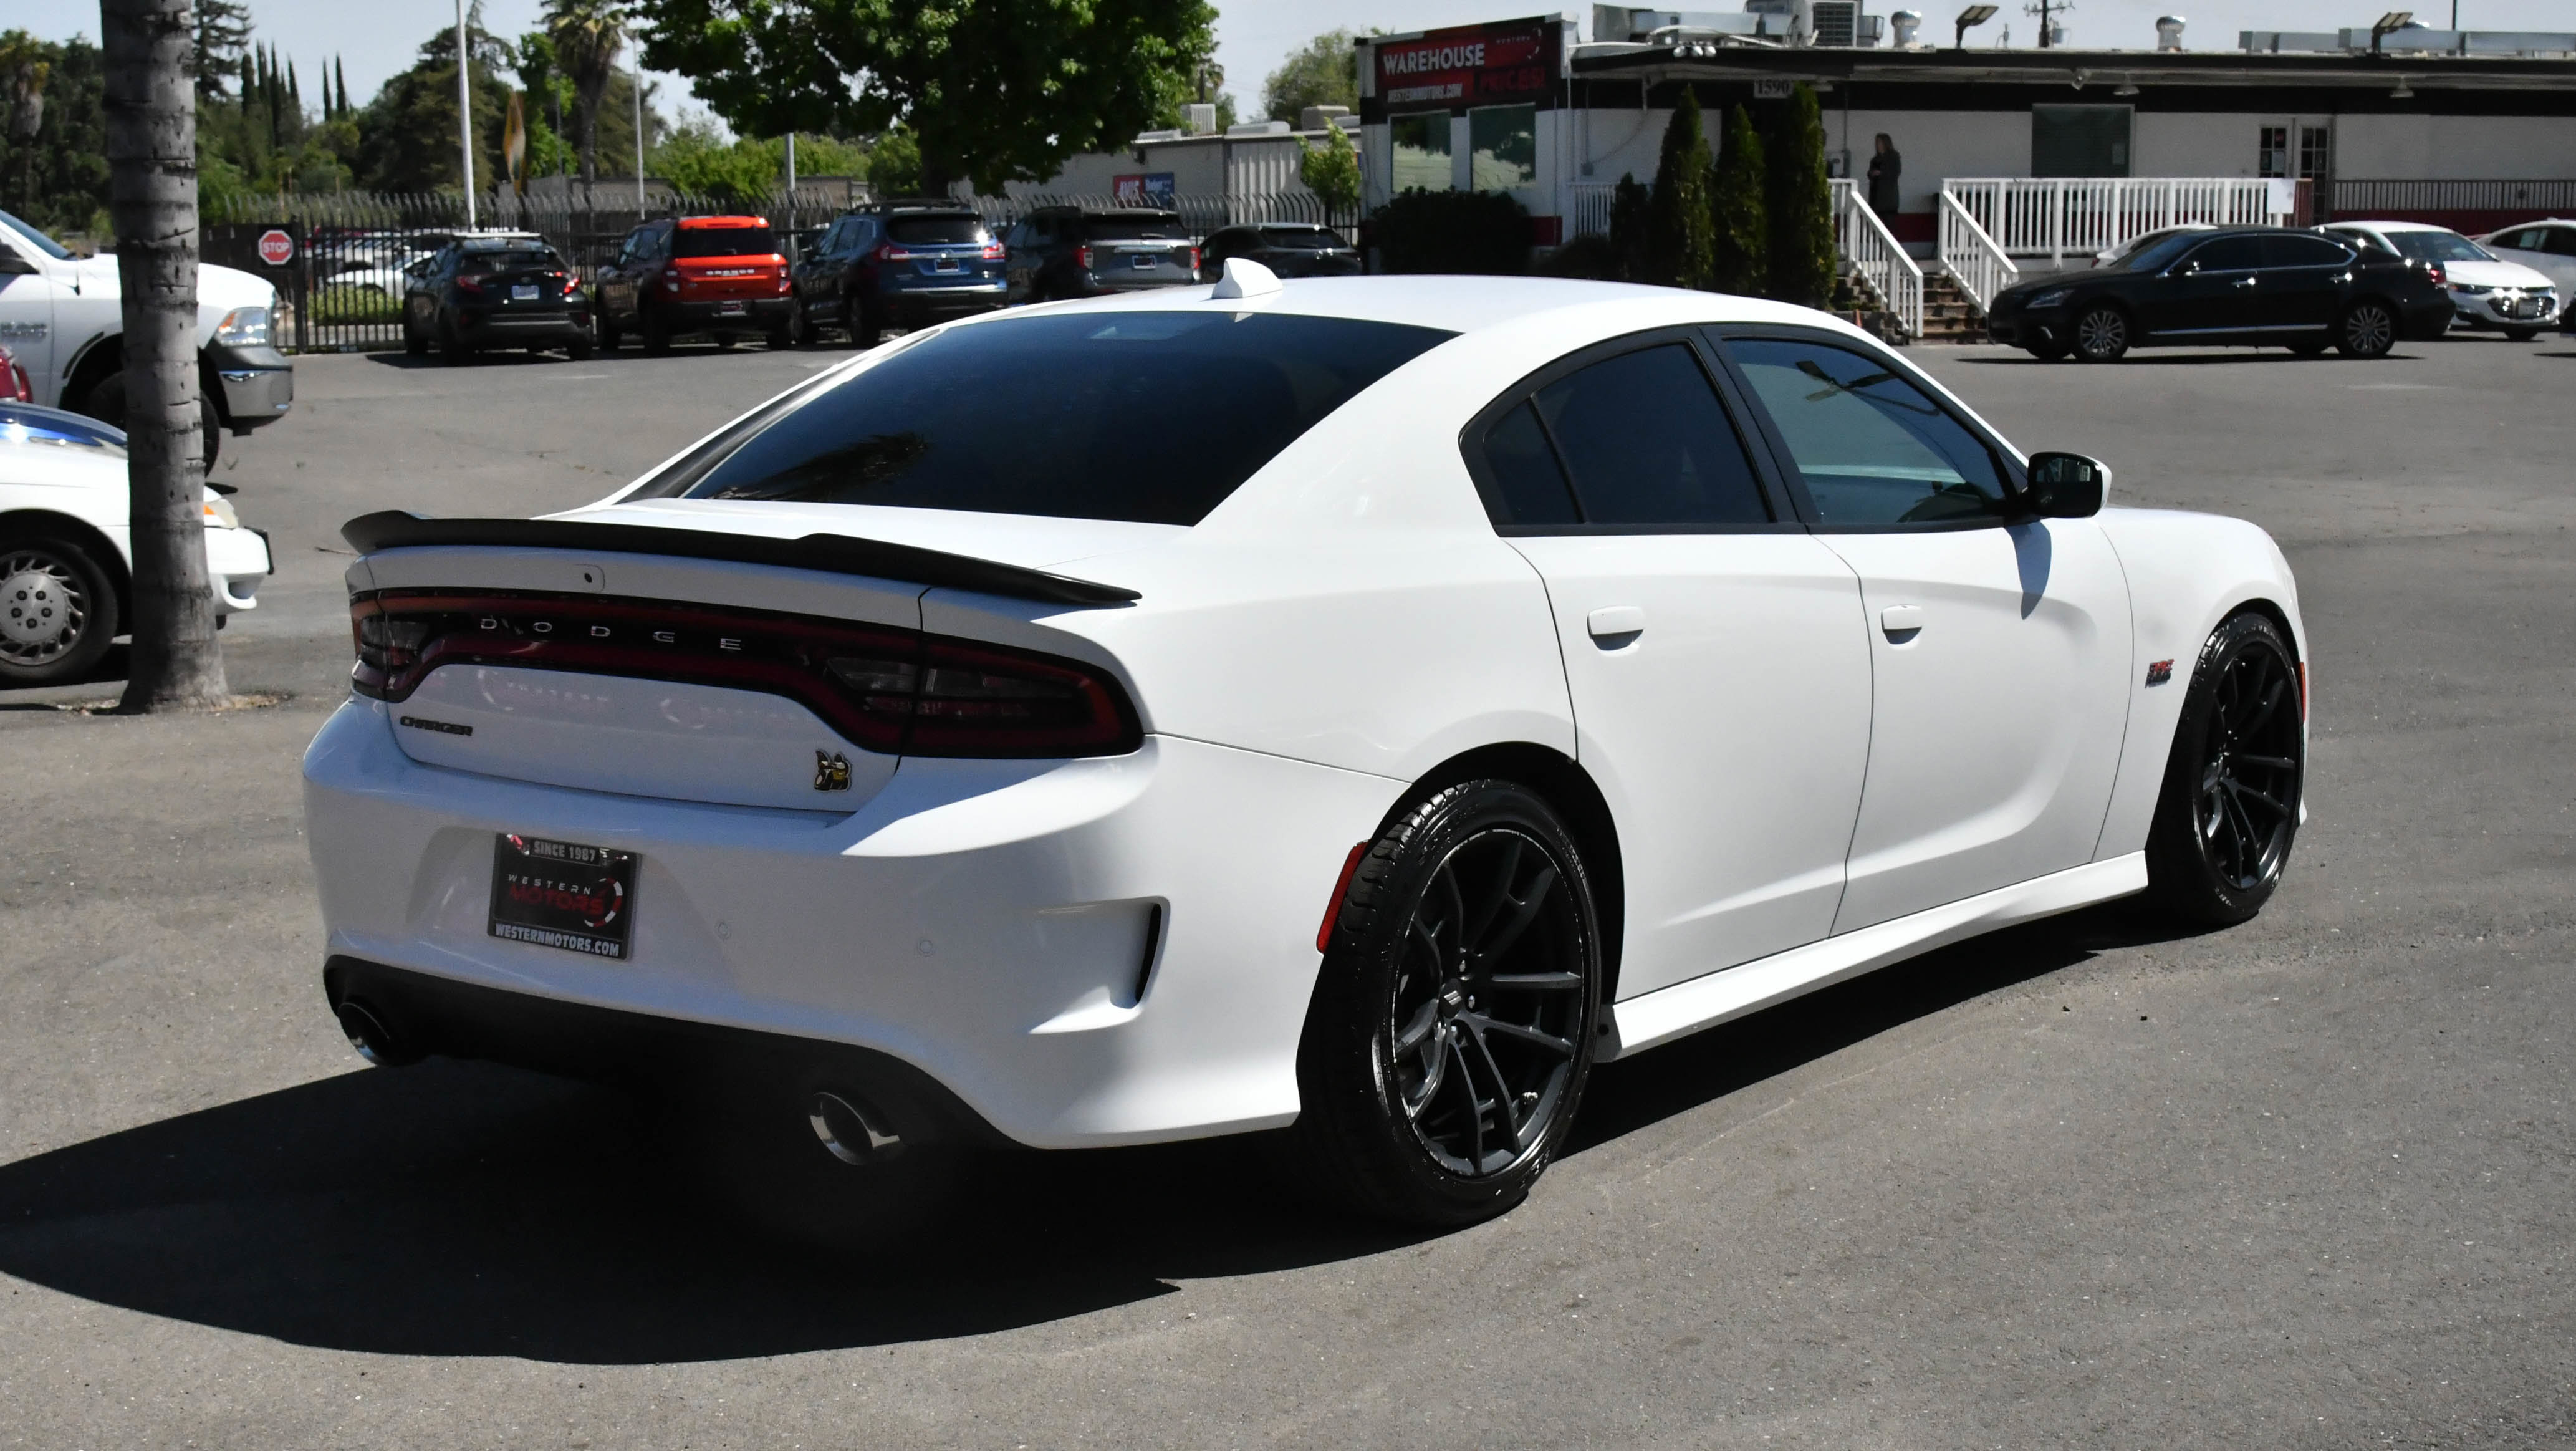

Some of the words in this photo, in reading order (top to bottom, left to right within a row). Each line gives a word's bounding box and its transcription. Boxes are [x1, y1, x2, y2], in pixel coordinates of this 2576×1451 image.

[1383, 43, 1486, 75] WAREHOUSE
[1757, 79, 1790, 95] 1590
[262, 242, 290, 253] STOP
[481, 618, 742, 650] DODGE
[400, 716, 473, 736] CHARGER
[534, 841, 565, 857] SINCE
[569, 847, 596, 862] 1987
[508, 874, 591, 895] WESTERN
[509, 884, 605, 915] MOTORS
[496, 923, 620, 957] WESTERNMOTORS.COM
